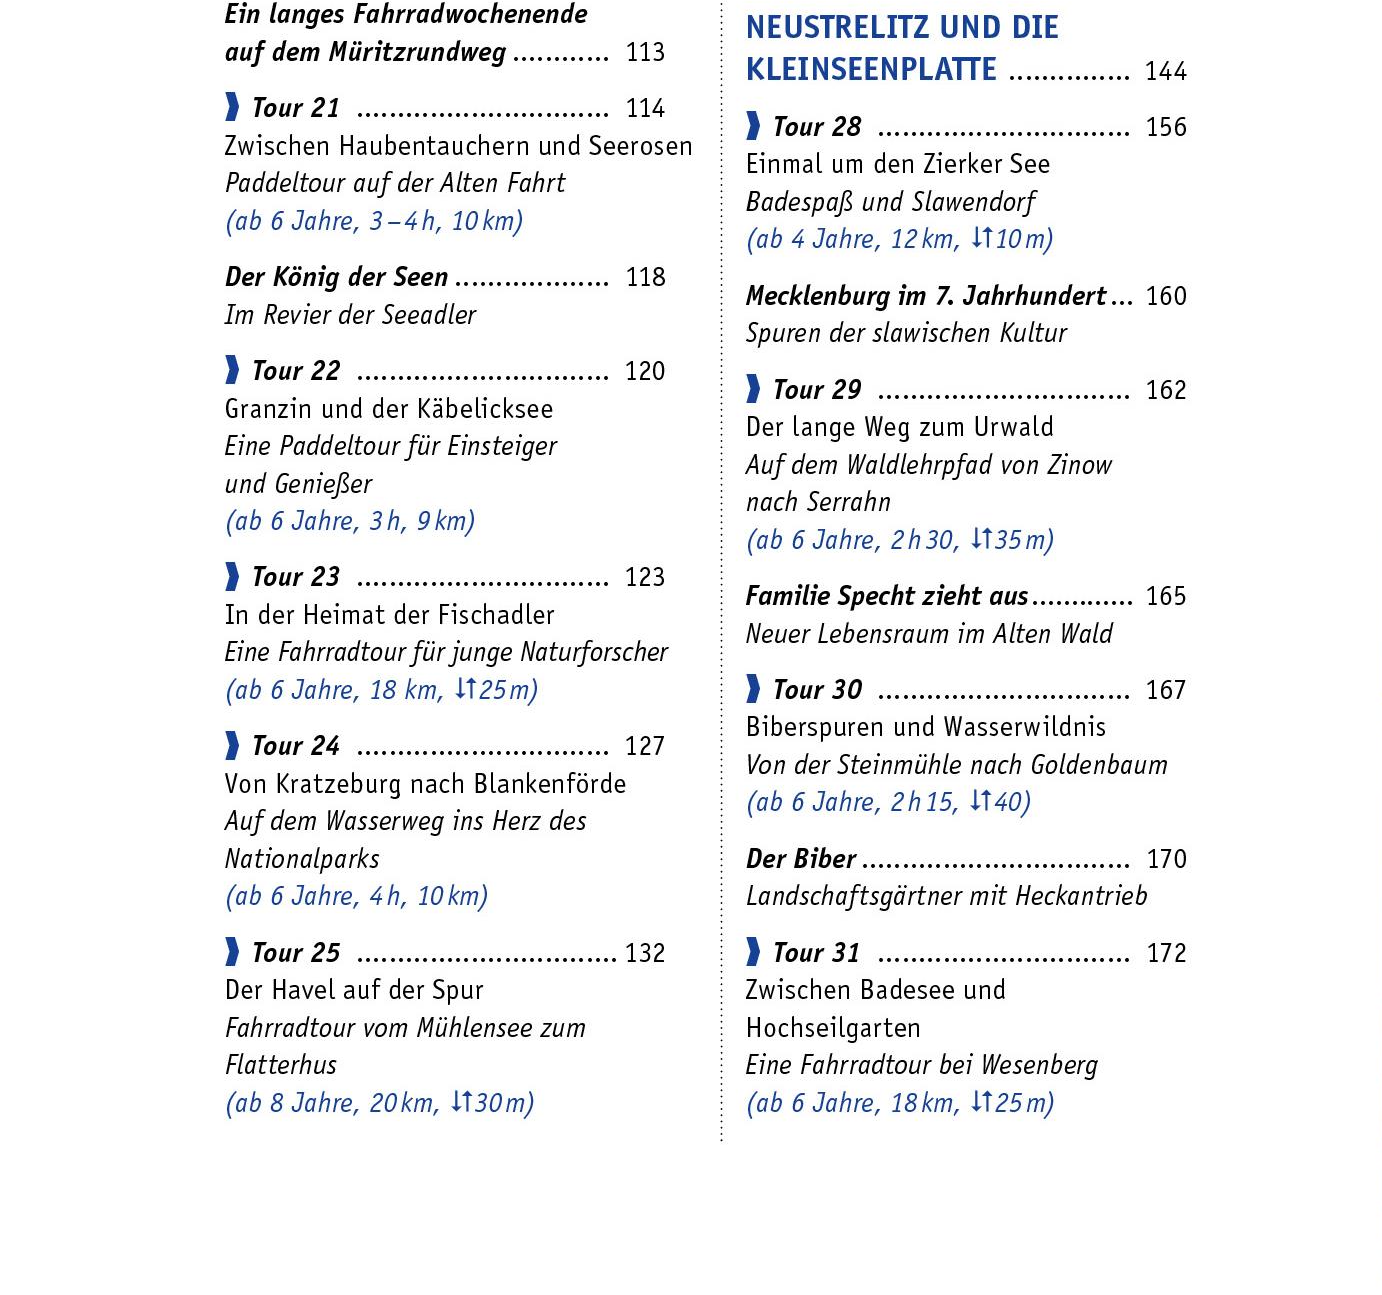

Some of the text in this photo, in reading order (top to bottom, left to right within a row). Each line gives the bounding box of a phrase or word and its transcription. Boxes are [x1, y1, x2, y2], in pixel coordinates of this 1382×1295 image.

[224, 1, 588, 30] Ein langes Fahrradwochenende
[747, 14, 1059, 39] NEUSTRELITZ UND DIE
[747, 56, 1188, 81] KLEINSEENPLATTE 144
[745, 189, 1039, 218] Badespaß und Slawendorf
[225, 471, 374, 500] und Genießer
[747, 714, 1106, 743] Biberspuren und Wasserwildnis
[224, 771, 626, 800] Von Kratzeburg nach Blankenförde
[224, 846, 380, 875] Nationalparks
[746, 883, 1148, 912] Landschaftsgärtner mit Heckantrieb
[253, 941, 665, 963] Tour 25 132
[747, 1015, 920, 1044] Hochseilgarten
[225, 1052, 337, 1075] Flatterhus
